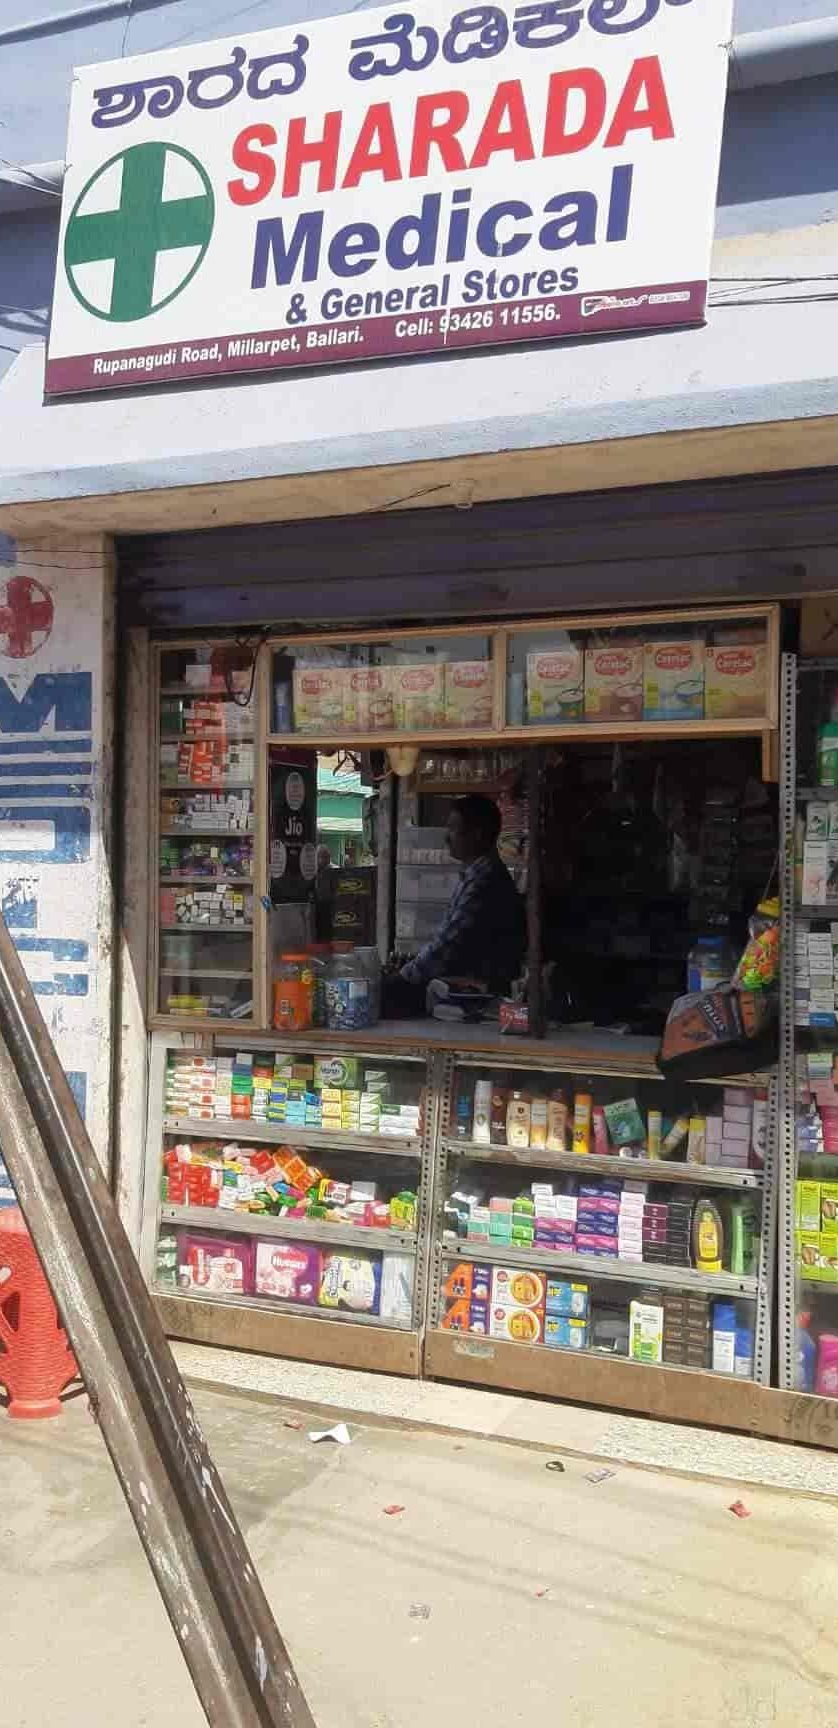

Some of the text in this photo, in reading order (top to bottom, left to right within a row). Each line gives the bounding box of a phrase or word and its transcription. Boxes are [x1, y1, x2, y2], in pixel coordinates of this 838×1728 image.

[92, 33, 308, 129] ಶಾರದ
[228, 55, 674, 207] SHARADA
[251, 165, 632, 289] Medical
[286, 293, 307, 325] &
[320, 273, 450, 319] General
[461, 264, 579, 307] Stores
[93, 348, 177, 377] Rupanagudi
[181, 342, 223, 364] Road,
[227, 334, 301, 358] Millarpet,
[305, 325, 365, 349] Ballari.
[395, 317, 434, 338] Cell:
[439, 309, 494, 334] 93426
[500, 302, 561, 326] 11556.
[285, 817, 303, 836] Jio
